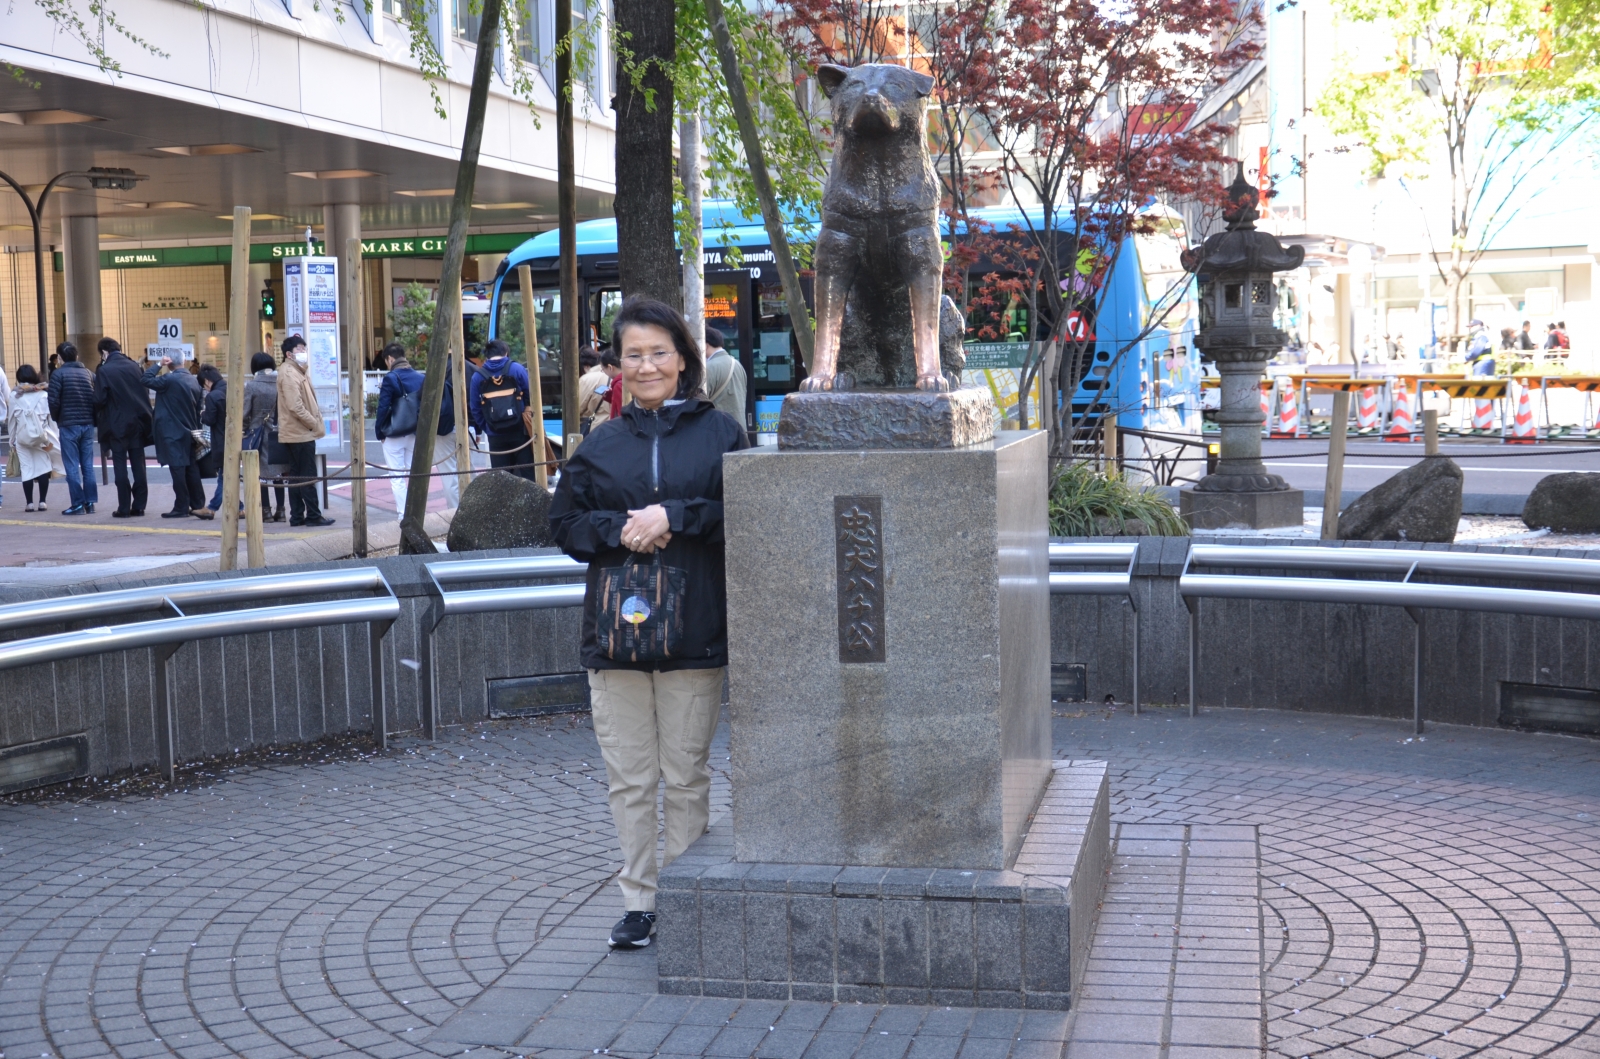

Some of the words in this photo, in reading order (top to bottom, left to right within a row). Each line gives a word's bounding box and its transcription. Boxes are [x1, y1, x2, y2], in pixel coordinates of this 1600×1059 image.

[1142, 111, 1183, 125] SLOT
[361, 241, 414, 254] MARK
[114, 255, 135, 264] EAST
[136, 254, 157, 263] MALL
[315, 264, 326, 274] 28
[178, 301, 207, 309] CITY
[159, 324, 179, 338] 40
[838, 506, 878, 651] 忠犬ハチ公
